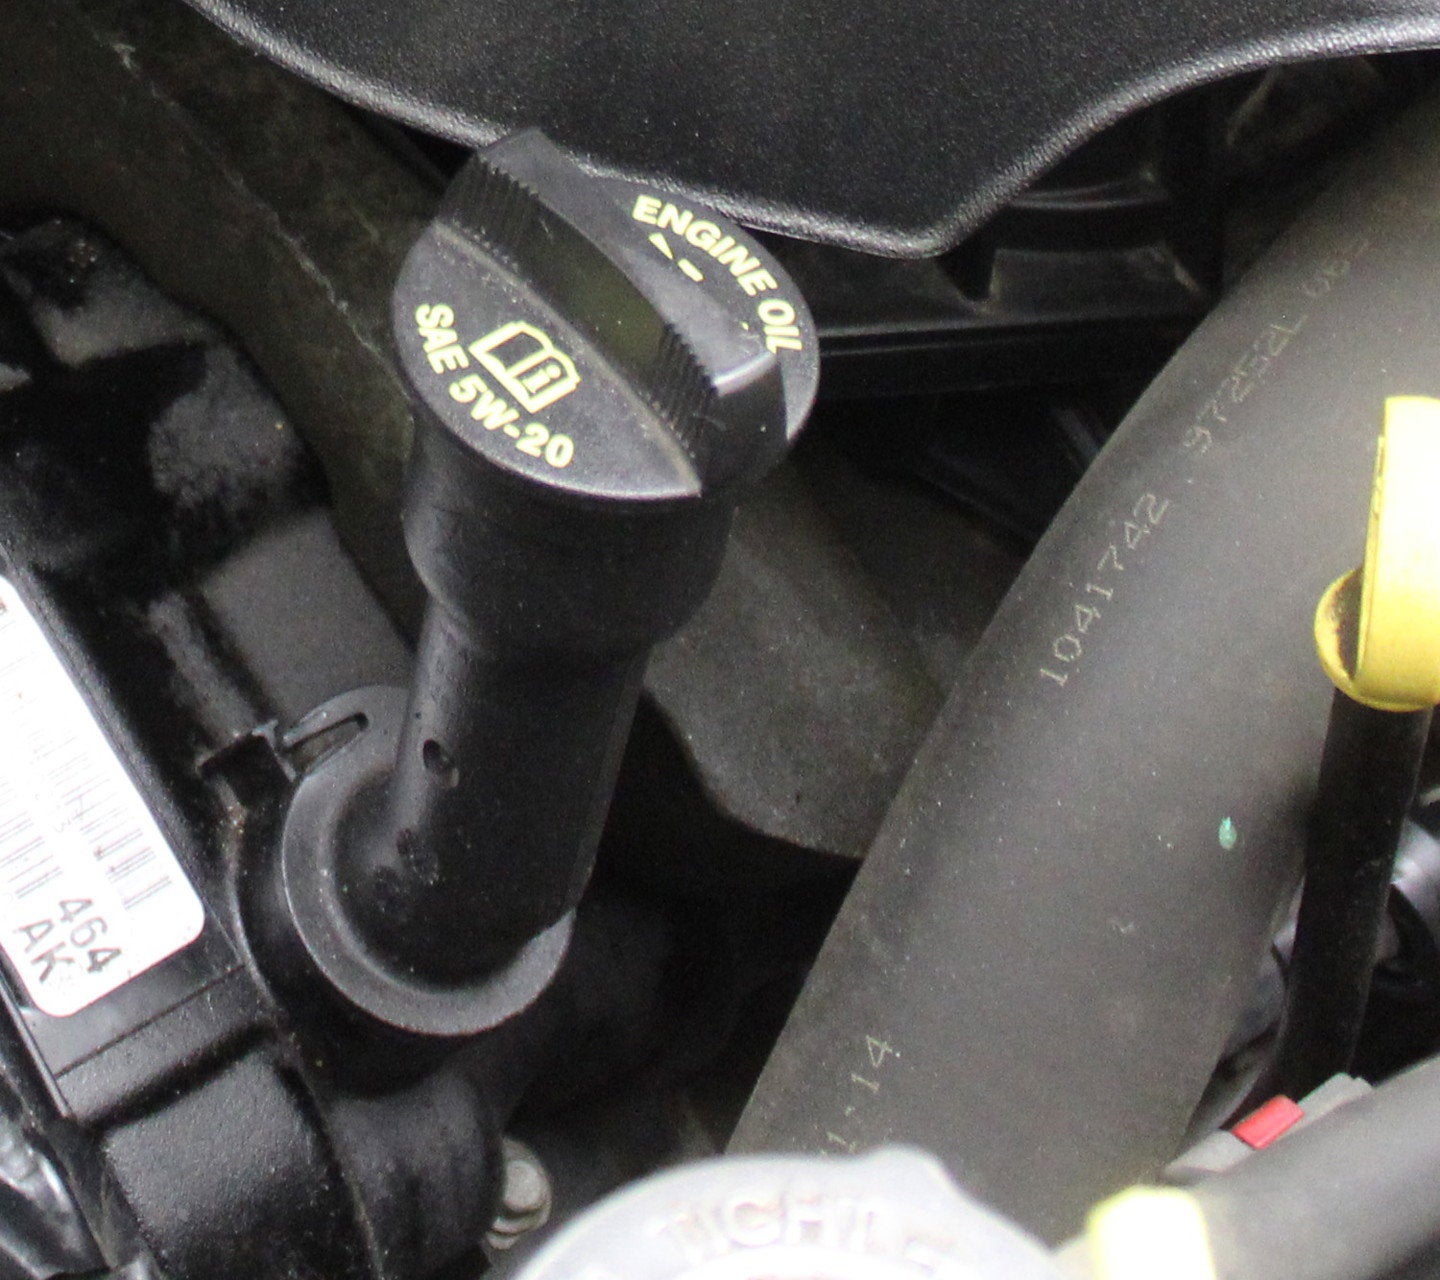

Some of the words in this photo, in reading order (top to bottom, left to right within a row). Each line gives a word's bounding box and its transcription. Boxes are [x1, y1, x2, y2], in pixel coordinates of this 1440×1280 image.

[631, 194, 779, 297] ENGINE
[756, 298, 803, 355] OIL
[415, 302, 470, 375] SAE
[448, 373, 575, 469] 5W-20
[1039, 492, 1171, 688] 1041742
[17, 919, 76, 986] AK
[57, 896, 123, 976] 464
